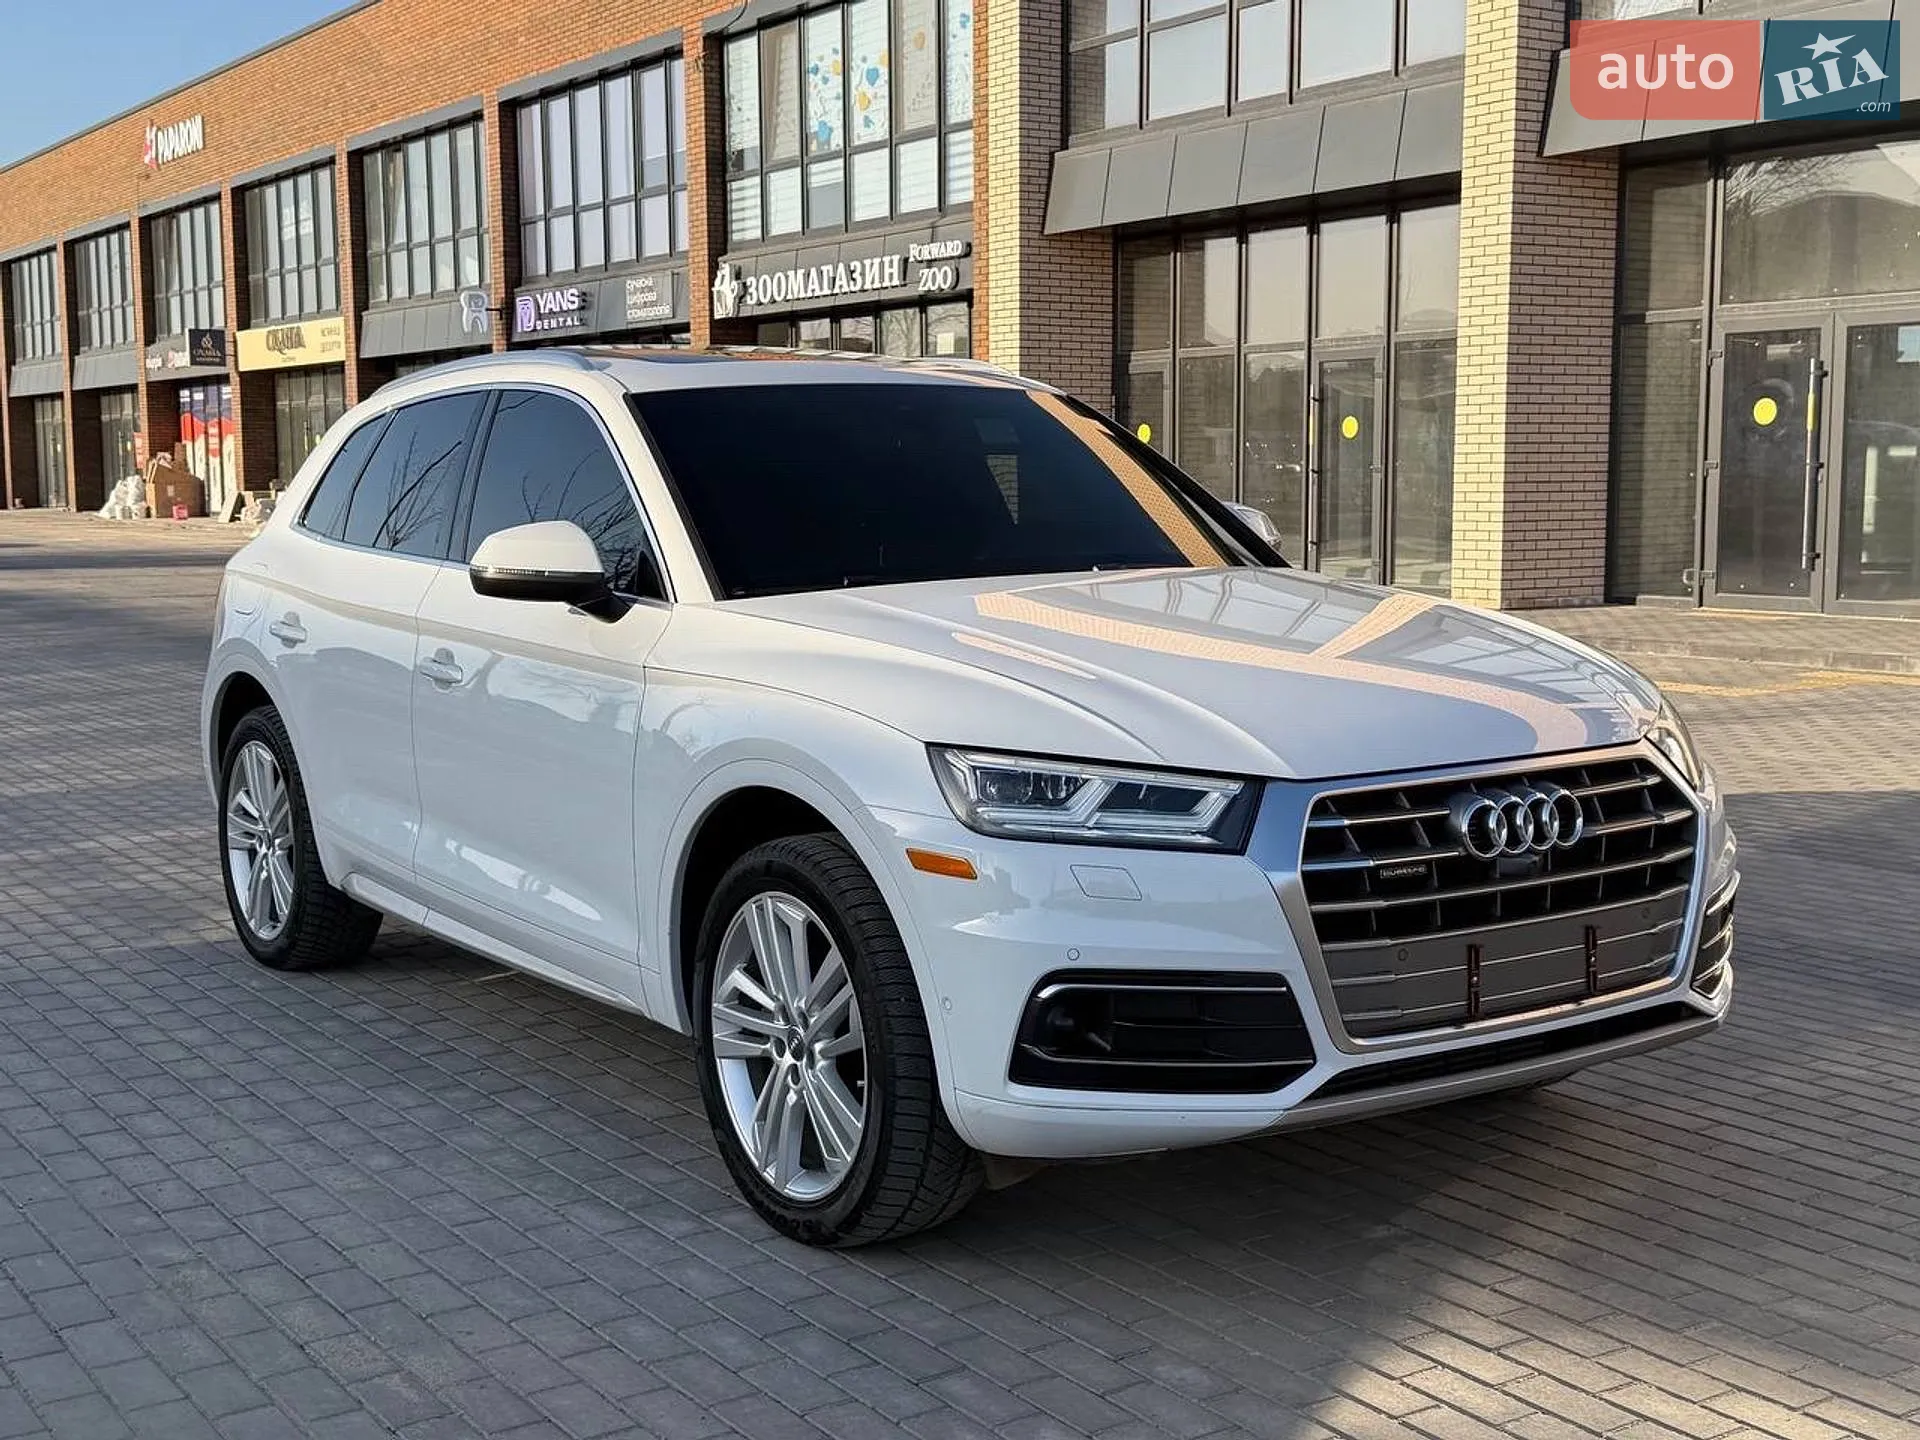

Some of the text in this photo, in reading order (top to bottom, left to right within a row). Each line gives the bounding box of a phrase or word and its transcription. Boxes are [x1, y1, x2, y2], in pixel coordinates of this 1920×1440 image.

[746, 254, 900, 305] ЗООМАГАЗИН
[918, 266, 951, 291] ZOO
[536, 288, 579, 314] YANS
[535, 316, 580, 330] DENTAL
